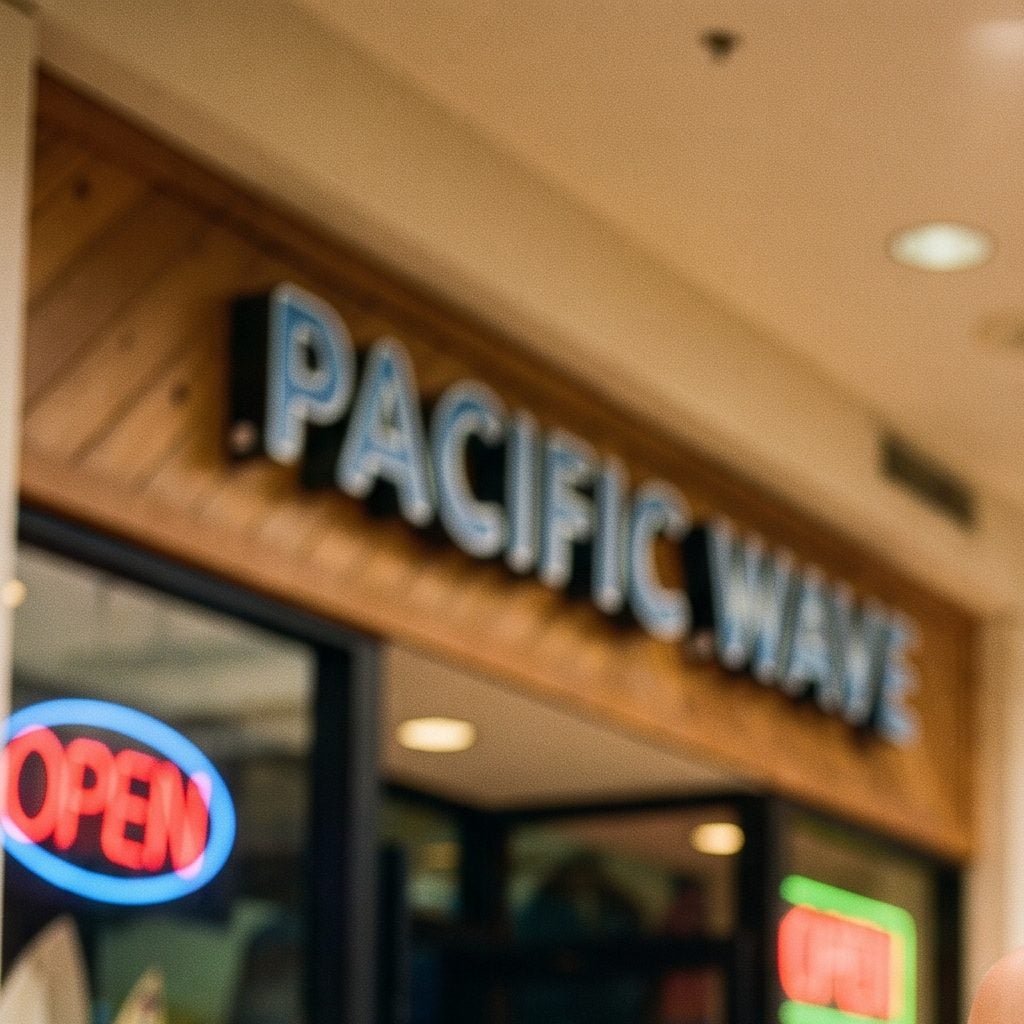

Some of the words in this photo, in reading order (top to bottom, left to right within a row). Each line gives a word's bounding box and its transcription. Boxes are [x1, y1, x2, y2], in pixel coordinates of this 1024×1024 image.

[263, 283, 696, 642] PACIFIC
[707, 515, 919, 746] WAVE
[3, 724, 212, 880] OPEN
